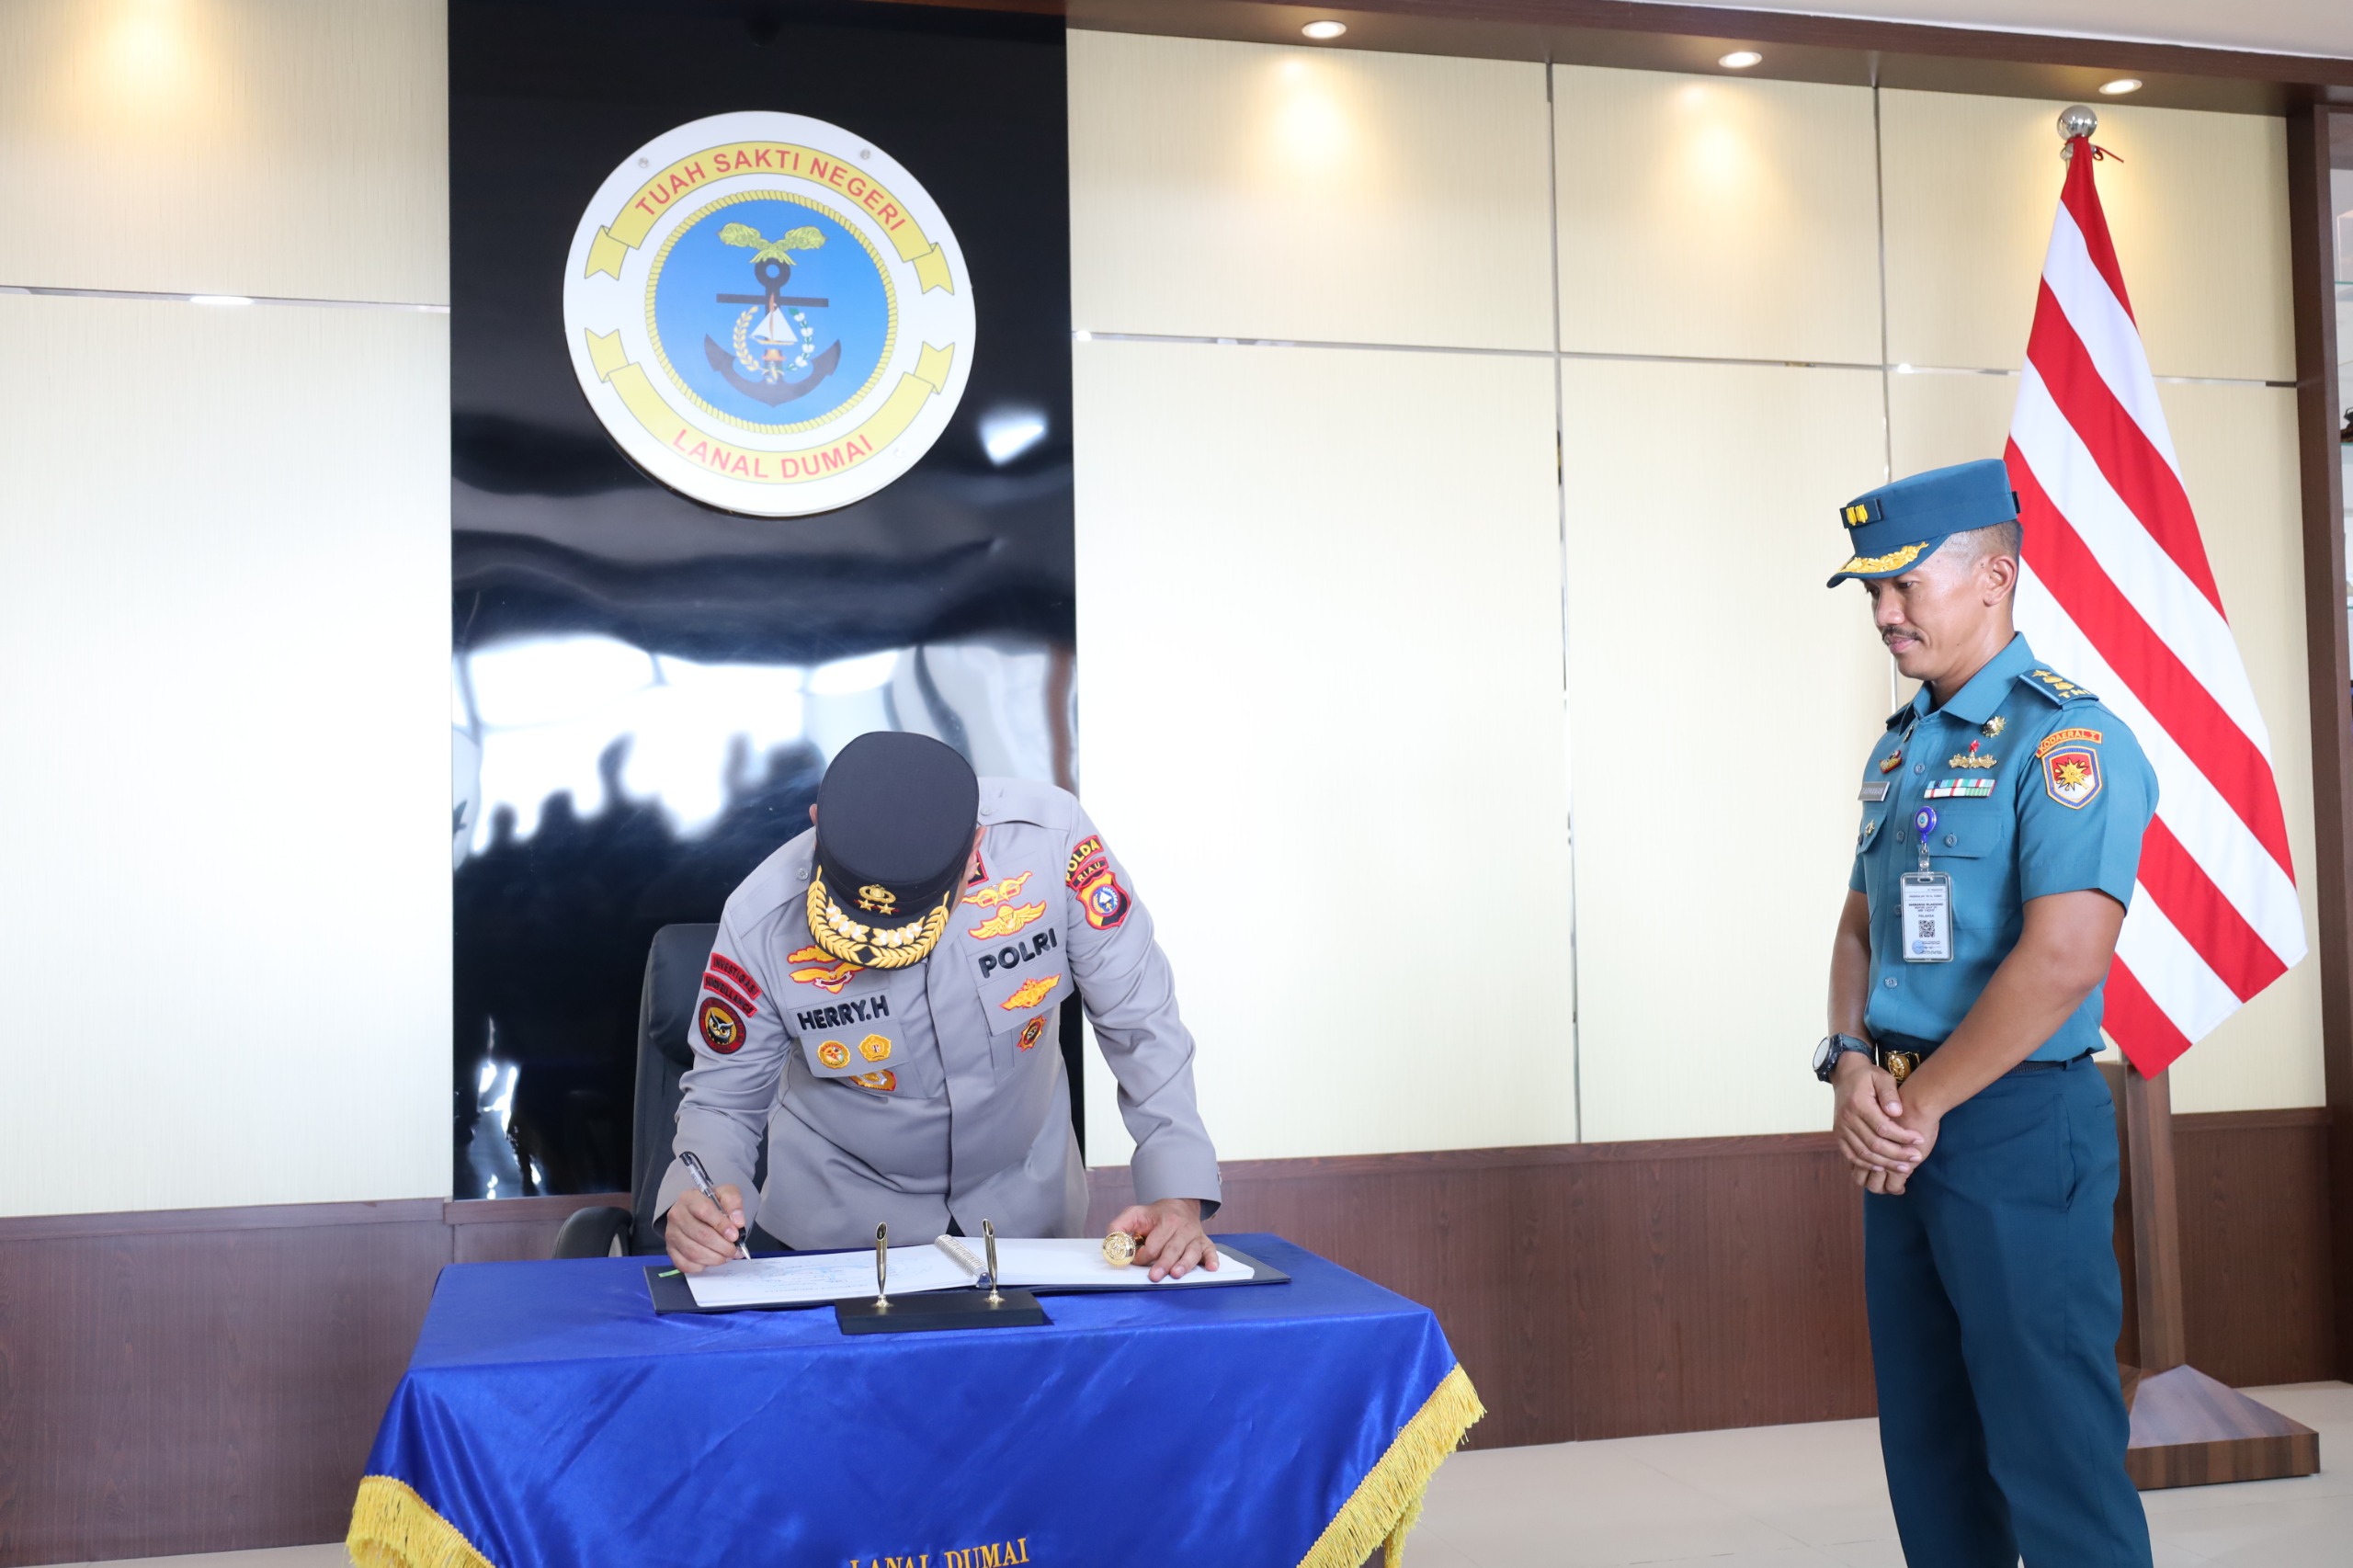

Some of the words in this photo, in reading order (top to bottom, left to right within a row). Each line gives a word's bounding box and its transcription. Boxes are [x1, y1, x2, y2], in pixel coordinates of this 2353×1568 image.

[635, 162, 707, 219] TUAH
[713, 148, 800, 173] SAKTI
[810, 157, 906, 232] NEGERI
[672, 428, 768, 479] LANAL
[781, 434, 873, 479] DUMAI
[2040, 730, 2086, 753] KODAERAL
[1065, 838, 1100, 881] POLDA
[1076, 861, 1101, 882] RIAU
[978, 927, 1058, 979] POLRI
[797, 994, 890, 1030] HERRY.H
[944, 1538, 1029, 1568] DUMAI
